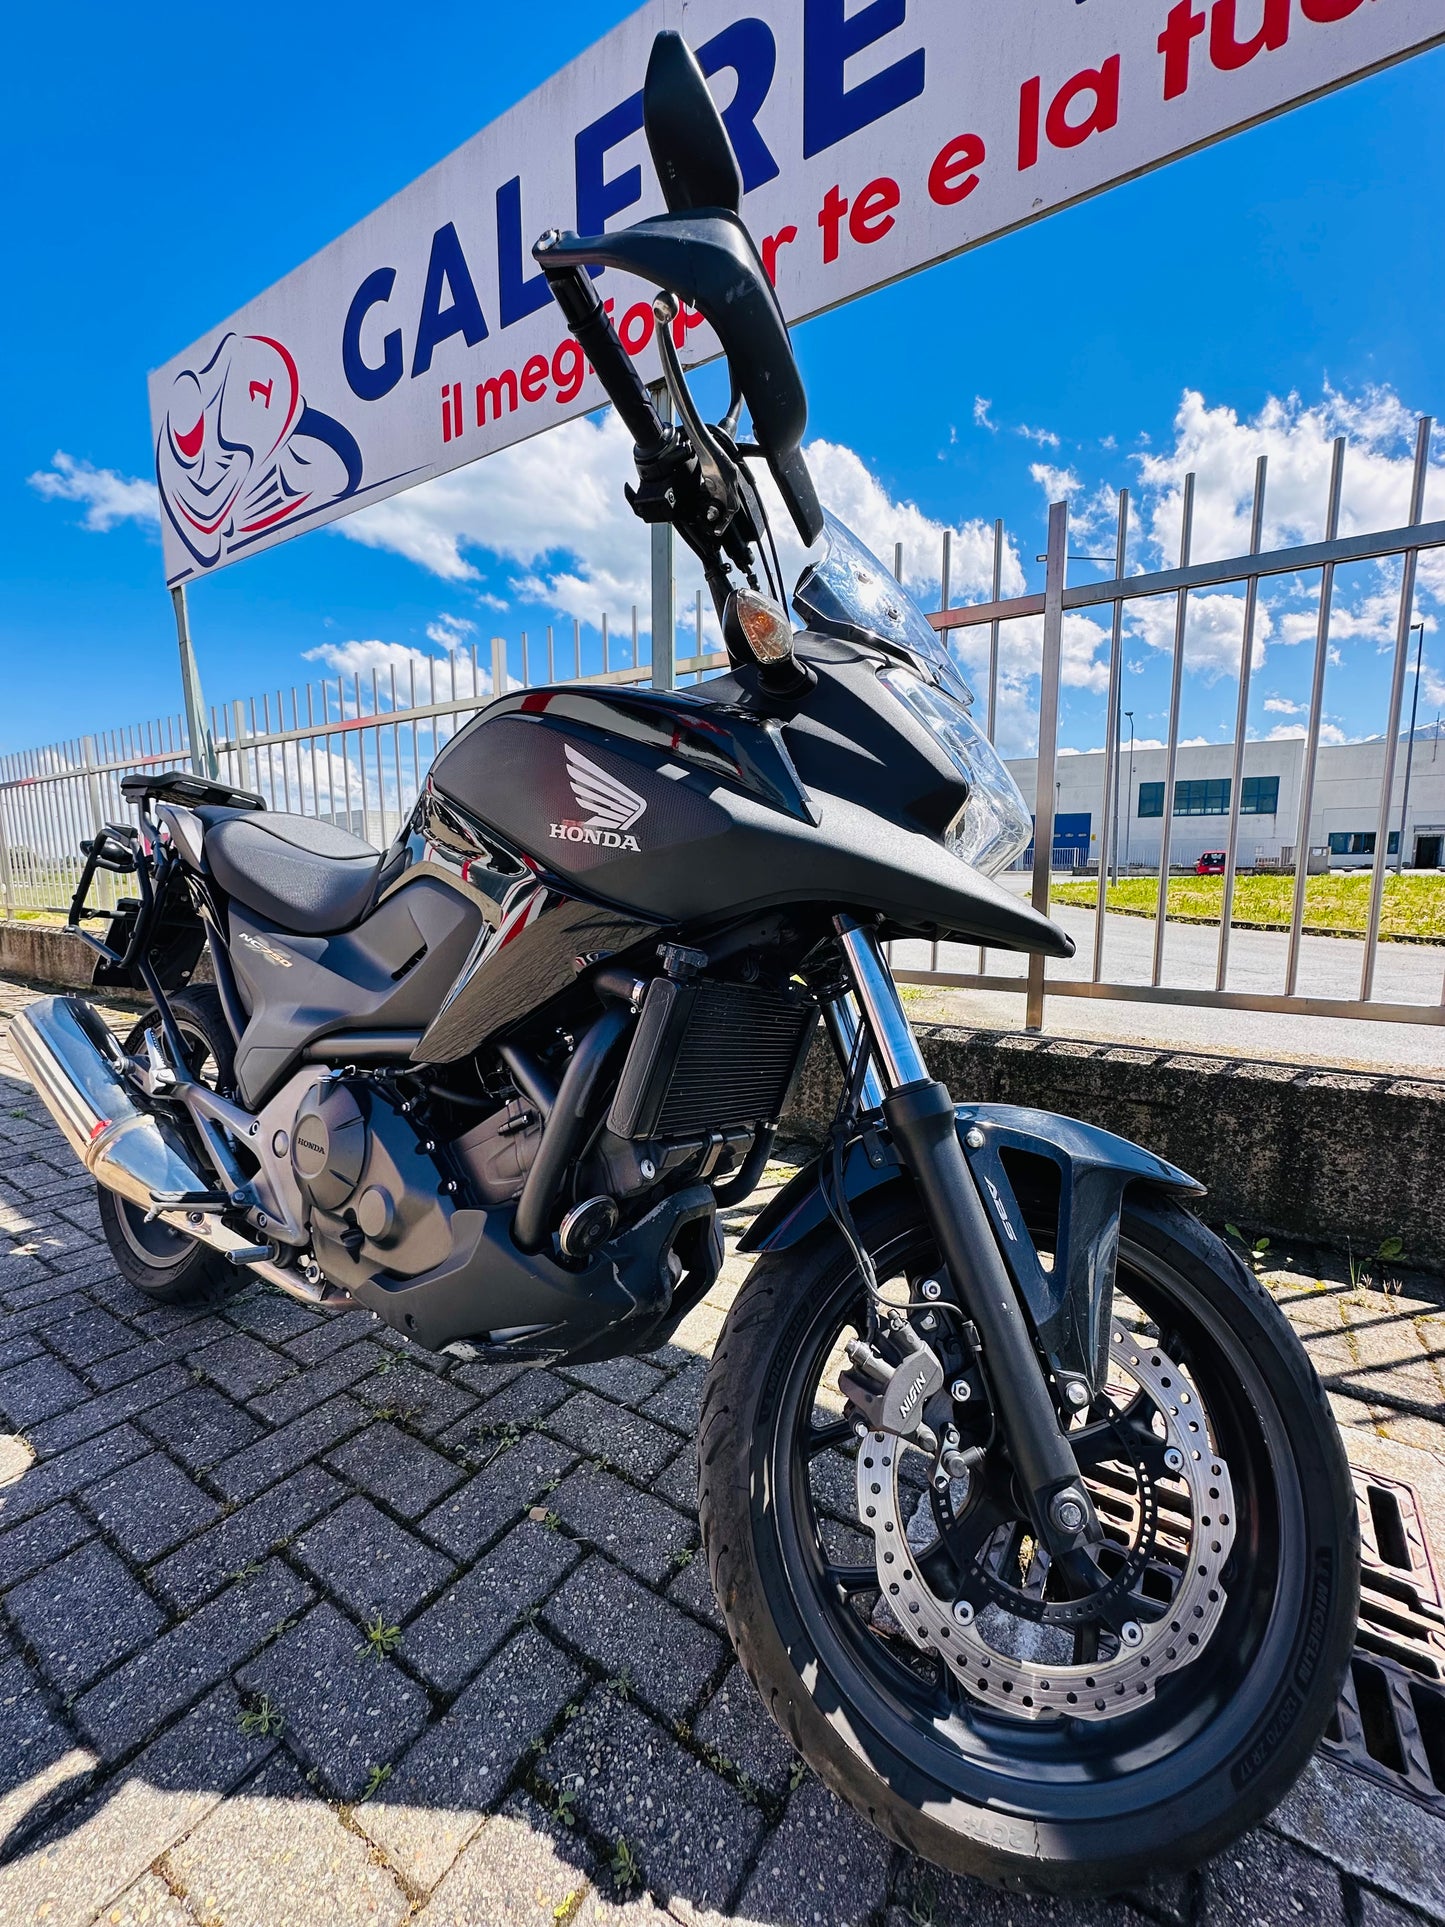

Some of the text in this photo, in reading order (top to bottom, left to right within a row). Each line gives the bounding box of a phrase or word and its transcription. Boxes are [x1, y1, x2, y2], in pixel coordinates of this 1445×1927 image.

[441, 377, 463, 443] il
[477, 297, 655, 428] mego
[817, 176, 901, 265] te
[927, 133, 986, 206] e
[1018, 53, 1121, 172] la
[548, 822, 642, 853] HONDA
[297, 1137, 326, 1155] HONDA
[983, 1175, 1018, 1242] ABS
[1298, 1584, 1332, 1687] MICHELIN
